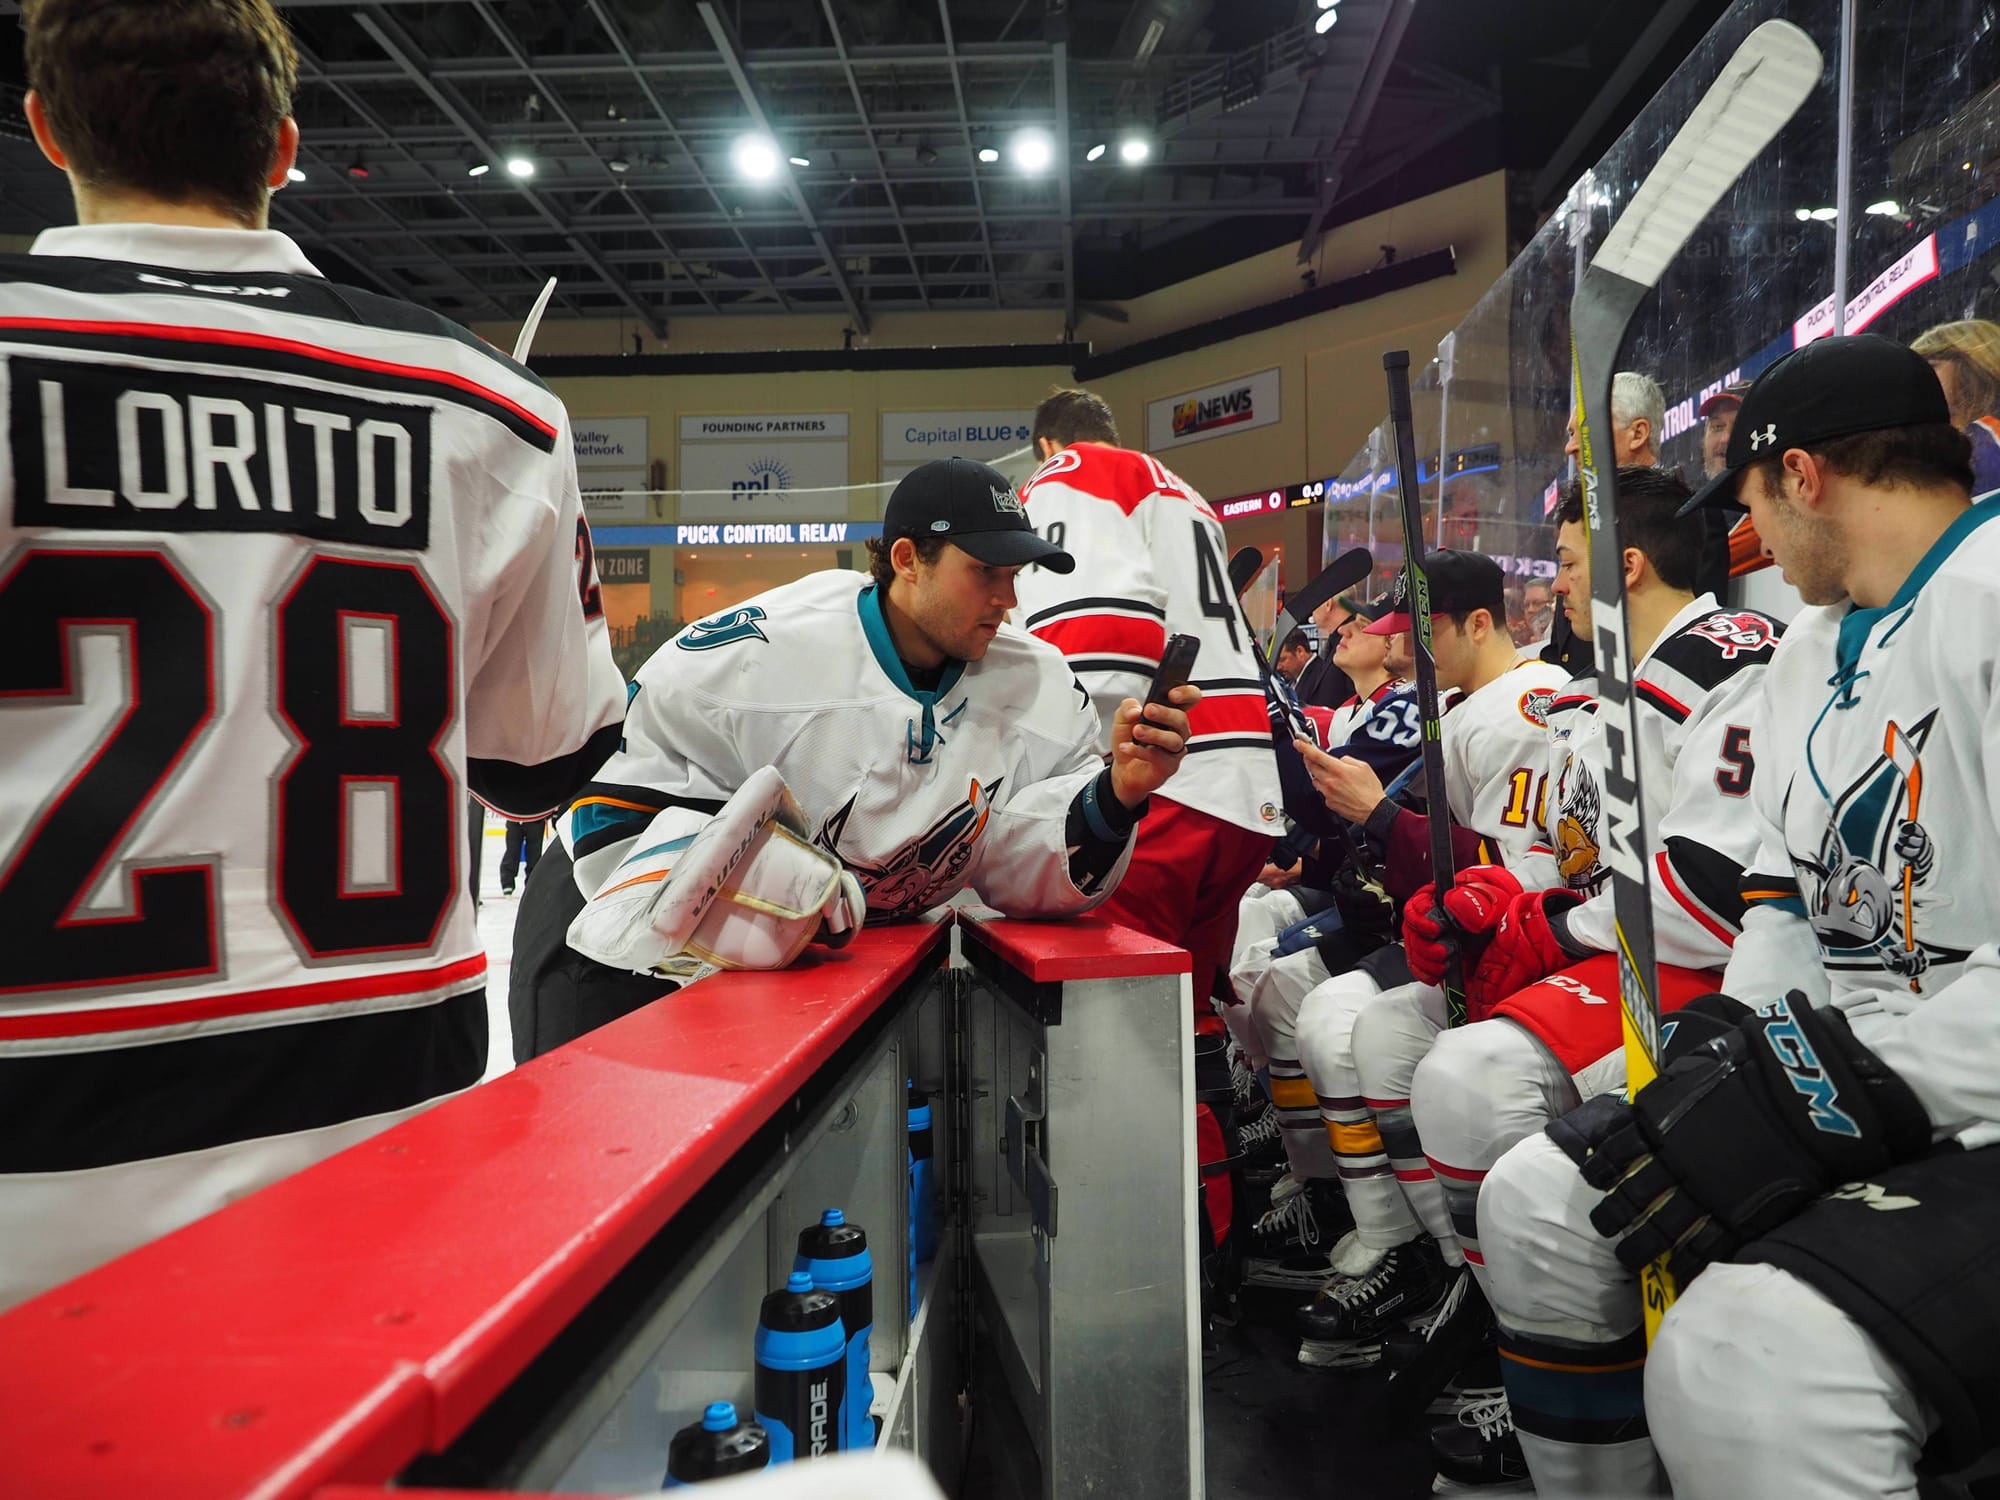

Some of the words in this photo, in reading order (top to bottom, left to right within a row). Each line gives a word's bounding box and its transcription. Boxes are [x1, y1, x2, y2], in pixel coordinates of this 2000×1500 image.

[1888, 253, 1914, 283] RELAY
[1198, 387, 1253, 421] NEWS
[573, 431, 610, 444] Valley
[702, 421, 764, 433] FOUNDING
[766, 420, 826, 432] PARTNERS
[905, 427, 962, 446] Capital
[39, 379, 412, 528] LORITO
[573, 442, 625, 456] Network
[731, 473, 770, 501] ppl
[1302, 482, 1325, 498] 0.0
[1223, 498, 1263, 516] EASTERN
[1268, 491, 1282, 509] 0
[677, 524, 720, 545] PUCK
[722, 523, 796, 545] CONTROL
[799, 522, 848, 544] RELAY
[608, 557, 645, 576] ZONE
[1418, 578, 1432, 638] CCM
[1592, 598, 1646, 886] CCM
[0, 538, 459, 993] 28
[692, 810, 768, 918] VAUGHN
[1532, 975, 1609, 1005] CM
